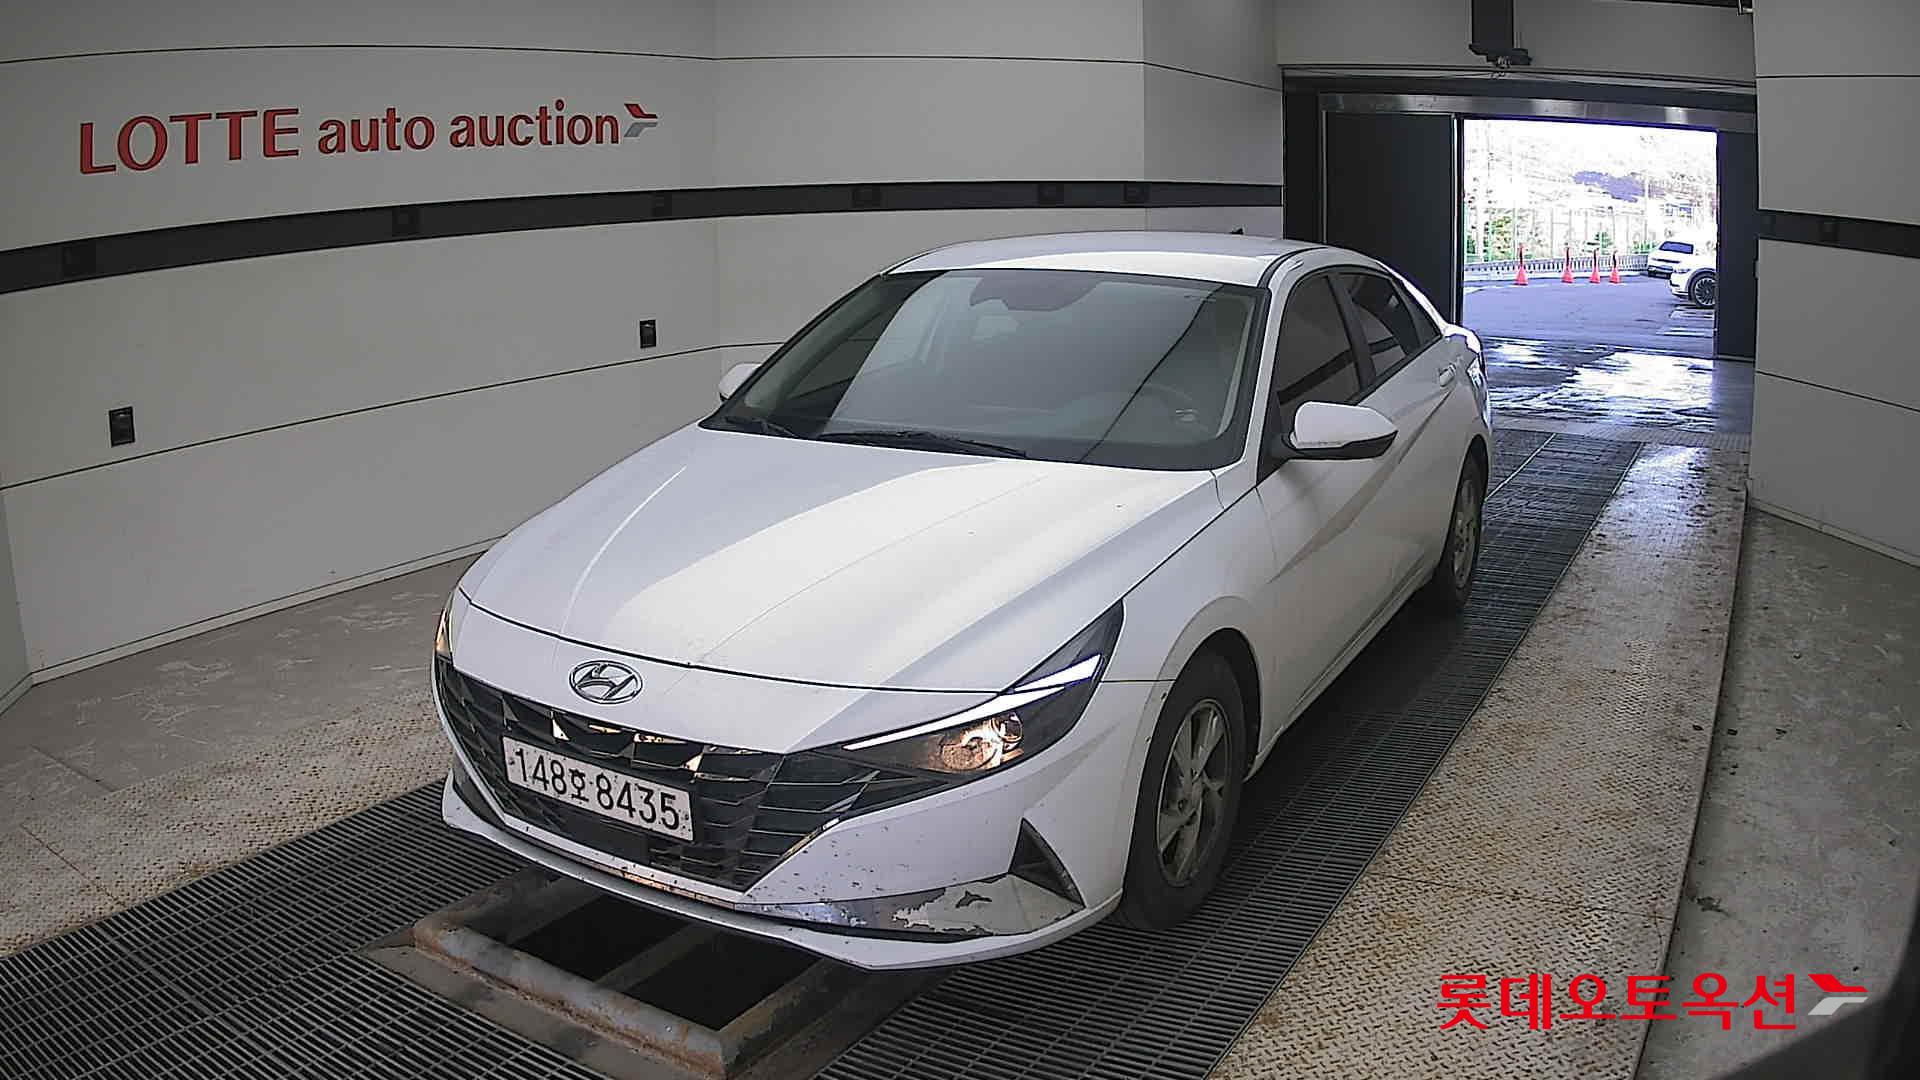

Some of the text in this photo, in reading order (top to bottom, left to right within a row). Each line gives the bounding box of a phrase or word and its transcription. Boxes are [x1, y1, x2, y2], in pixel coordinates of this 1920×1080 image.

[80, 98, 621, 175] LOTTE auto auction
[595, 772, 680, 830] 8435
